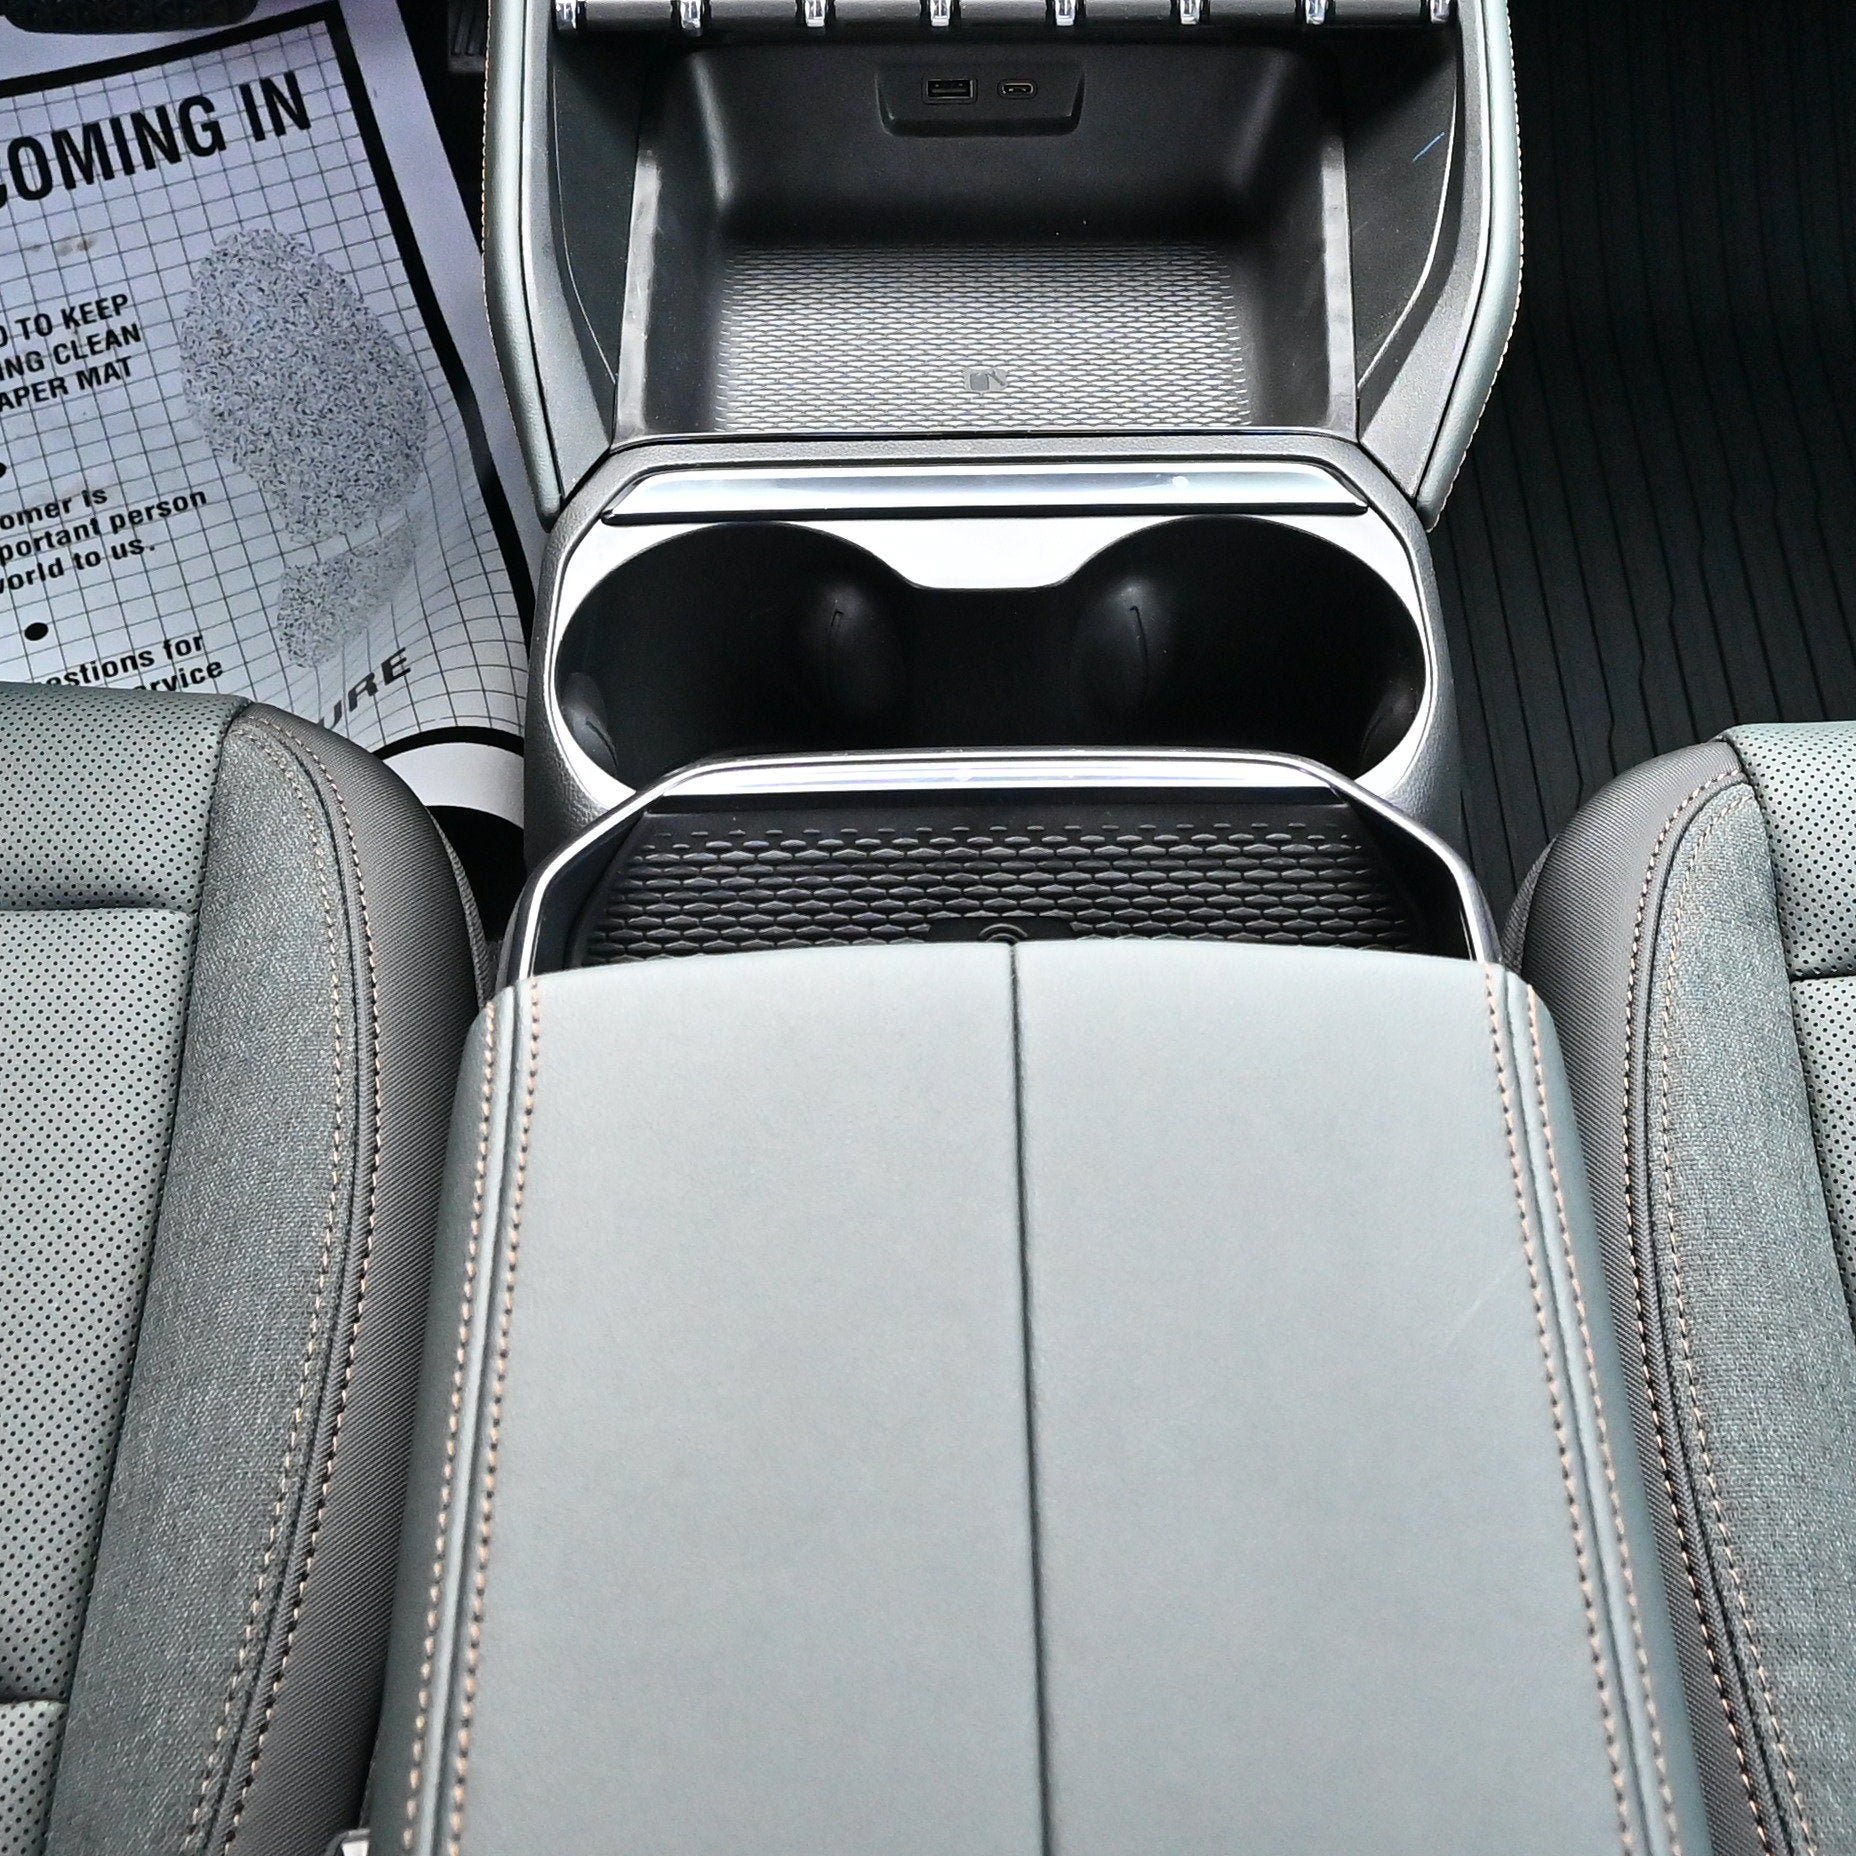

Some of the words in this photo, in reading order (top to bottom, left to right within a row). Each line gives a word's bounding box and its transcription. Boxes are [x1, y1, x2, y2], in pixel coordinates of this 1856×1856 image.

[239, 70, 312, 142] IN
[15, 312, 54, 341] TO
[61, 293, 130, 329] KEEP
[53, 323, 142, 366] CLEAN
[76, 355, 133, 391] MAT
[81, 487, 109, 509] is
[109, 490, 208, 535] person
[73, 548, 102, 571] to
[111, 539, 157, 561] us.
[162, 633, 204, 661] for
